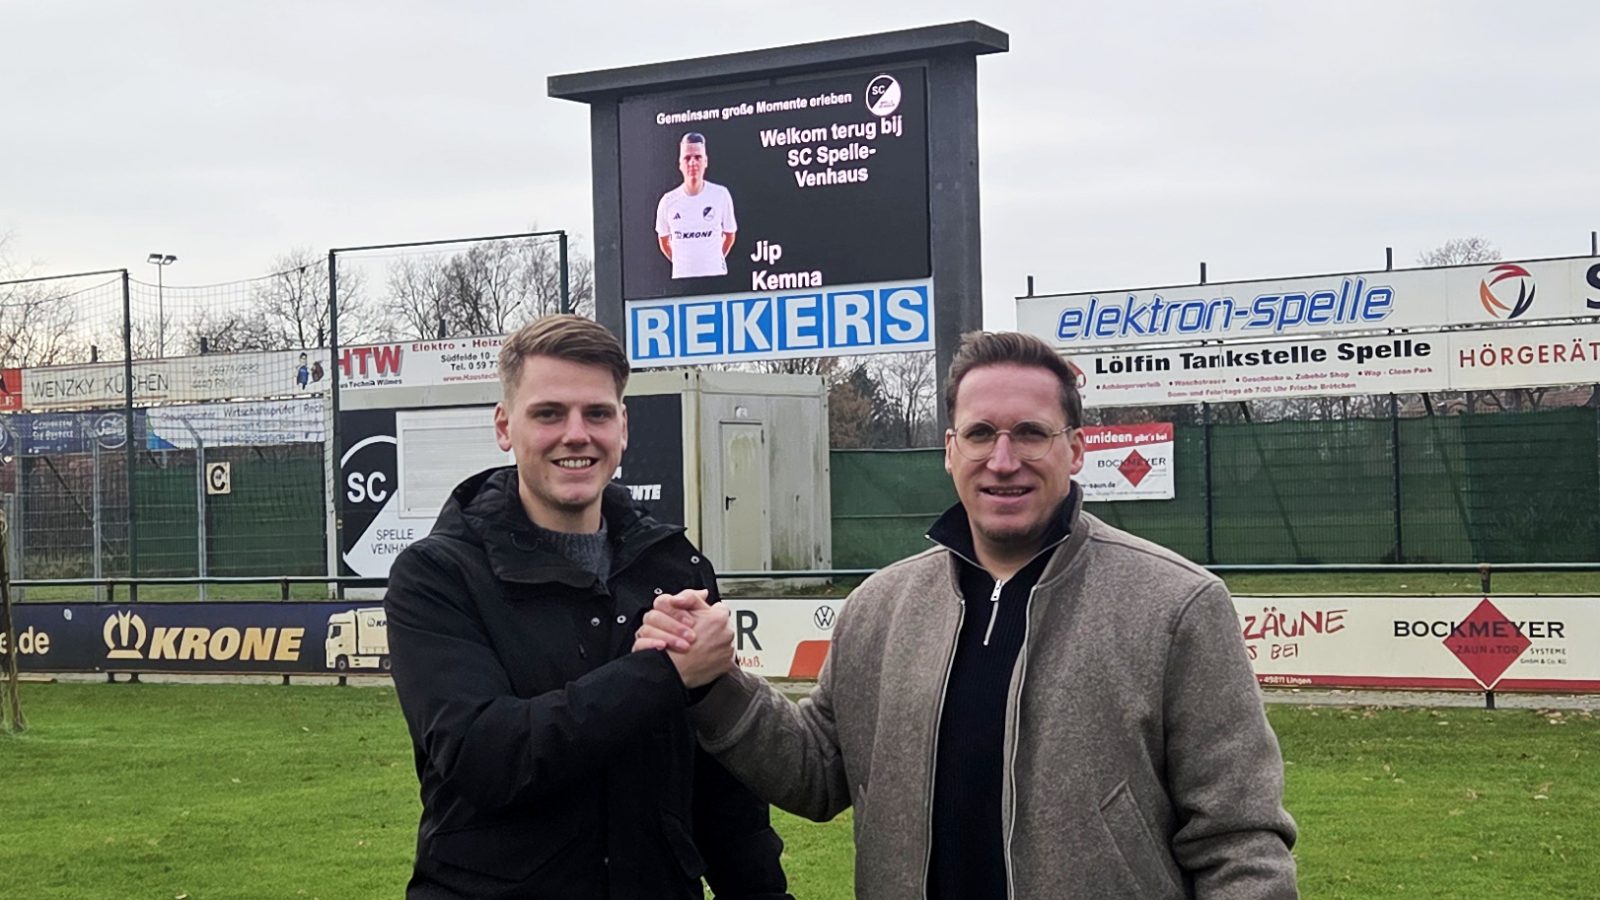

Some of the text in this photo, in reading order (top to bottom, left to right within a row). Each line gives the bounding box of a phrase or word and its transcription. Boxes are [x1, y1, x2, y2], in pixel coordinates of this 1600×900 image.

[872, 85, 885, 95] SC
[656, 92, 852, 125] Gemeinsam große Momente erleben
[760, 115, 903, 148] Welkom terug bij
[787, 142, 876, 167] SC Spelle-
[795, 166, 868, 188] Venhaus
[750, 240, 782, 265] Jip
[752, 270, 822, 291] Kemna
[1055, 276, 1396, 342] elektron-spelle
[636, 288, 926, 359] REKERS
[412, 342, 455, 352] Elektro
[441, 351, 491, 363] Südfelde 10
[1095, 339, 1431, 375] Lölfin Tankstelle Spelle
[1460, 339, 1600, 368] HÖRGERÄT
[450, 362, 466, 372] Tel.
[476, 360, 487, 370] 59
[1330, 371, 1350, 379] Shop
[1414, 366, 1433, 374] Park
[31, 378, 94, 398] WENZKY
[210, 465, 225, 491] C
[347, 471, 387, 503] SC
[376, 528, 414, 541] SPELLE
[1242, 606, 1349, 640] ZÄUNE
[1393, 620, 1566, 639] BOCKMEYER
[149, 626, 305, 661] KRONE
[1270, 643, 1298, 660] BEI
[1530, 647, 1567, 656] SYSTEME
[1286, 676, 1313, 686] Lingen
